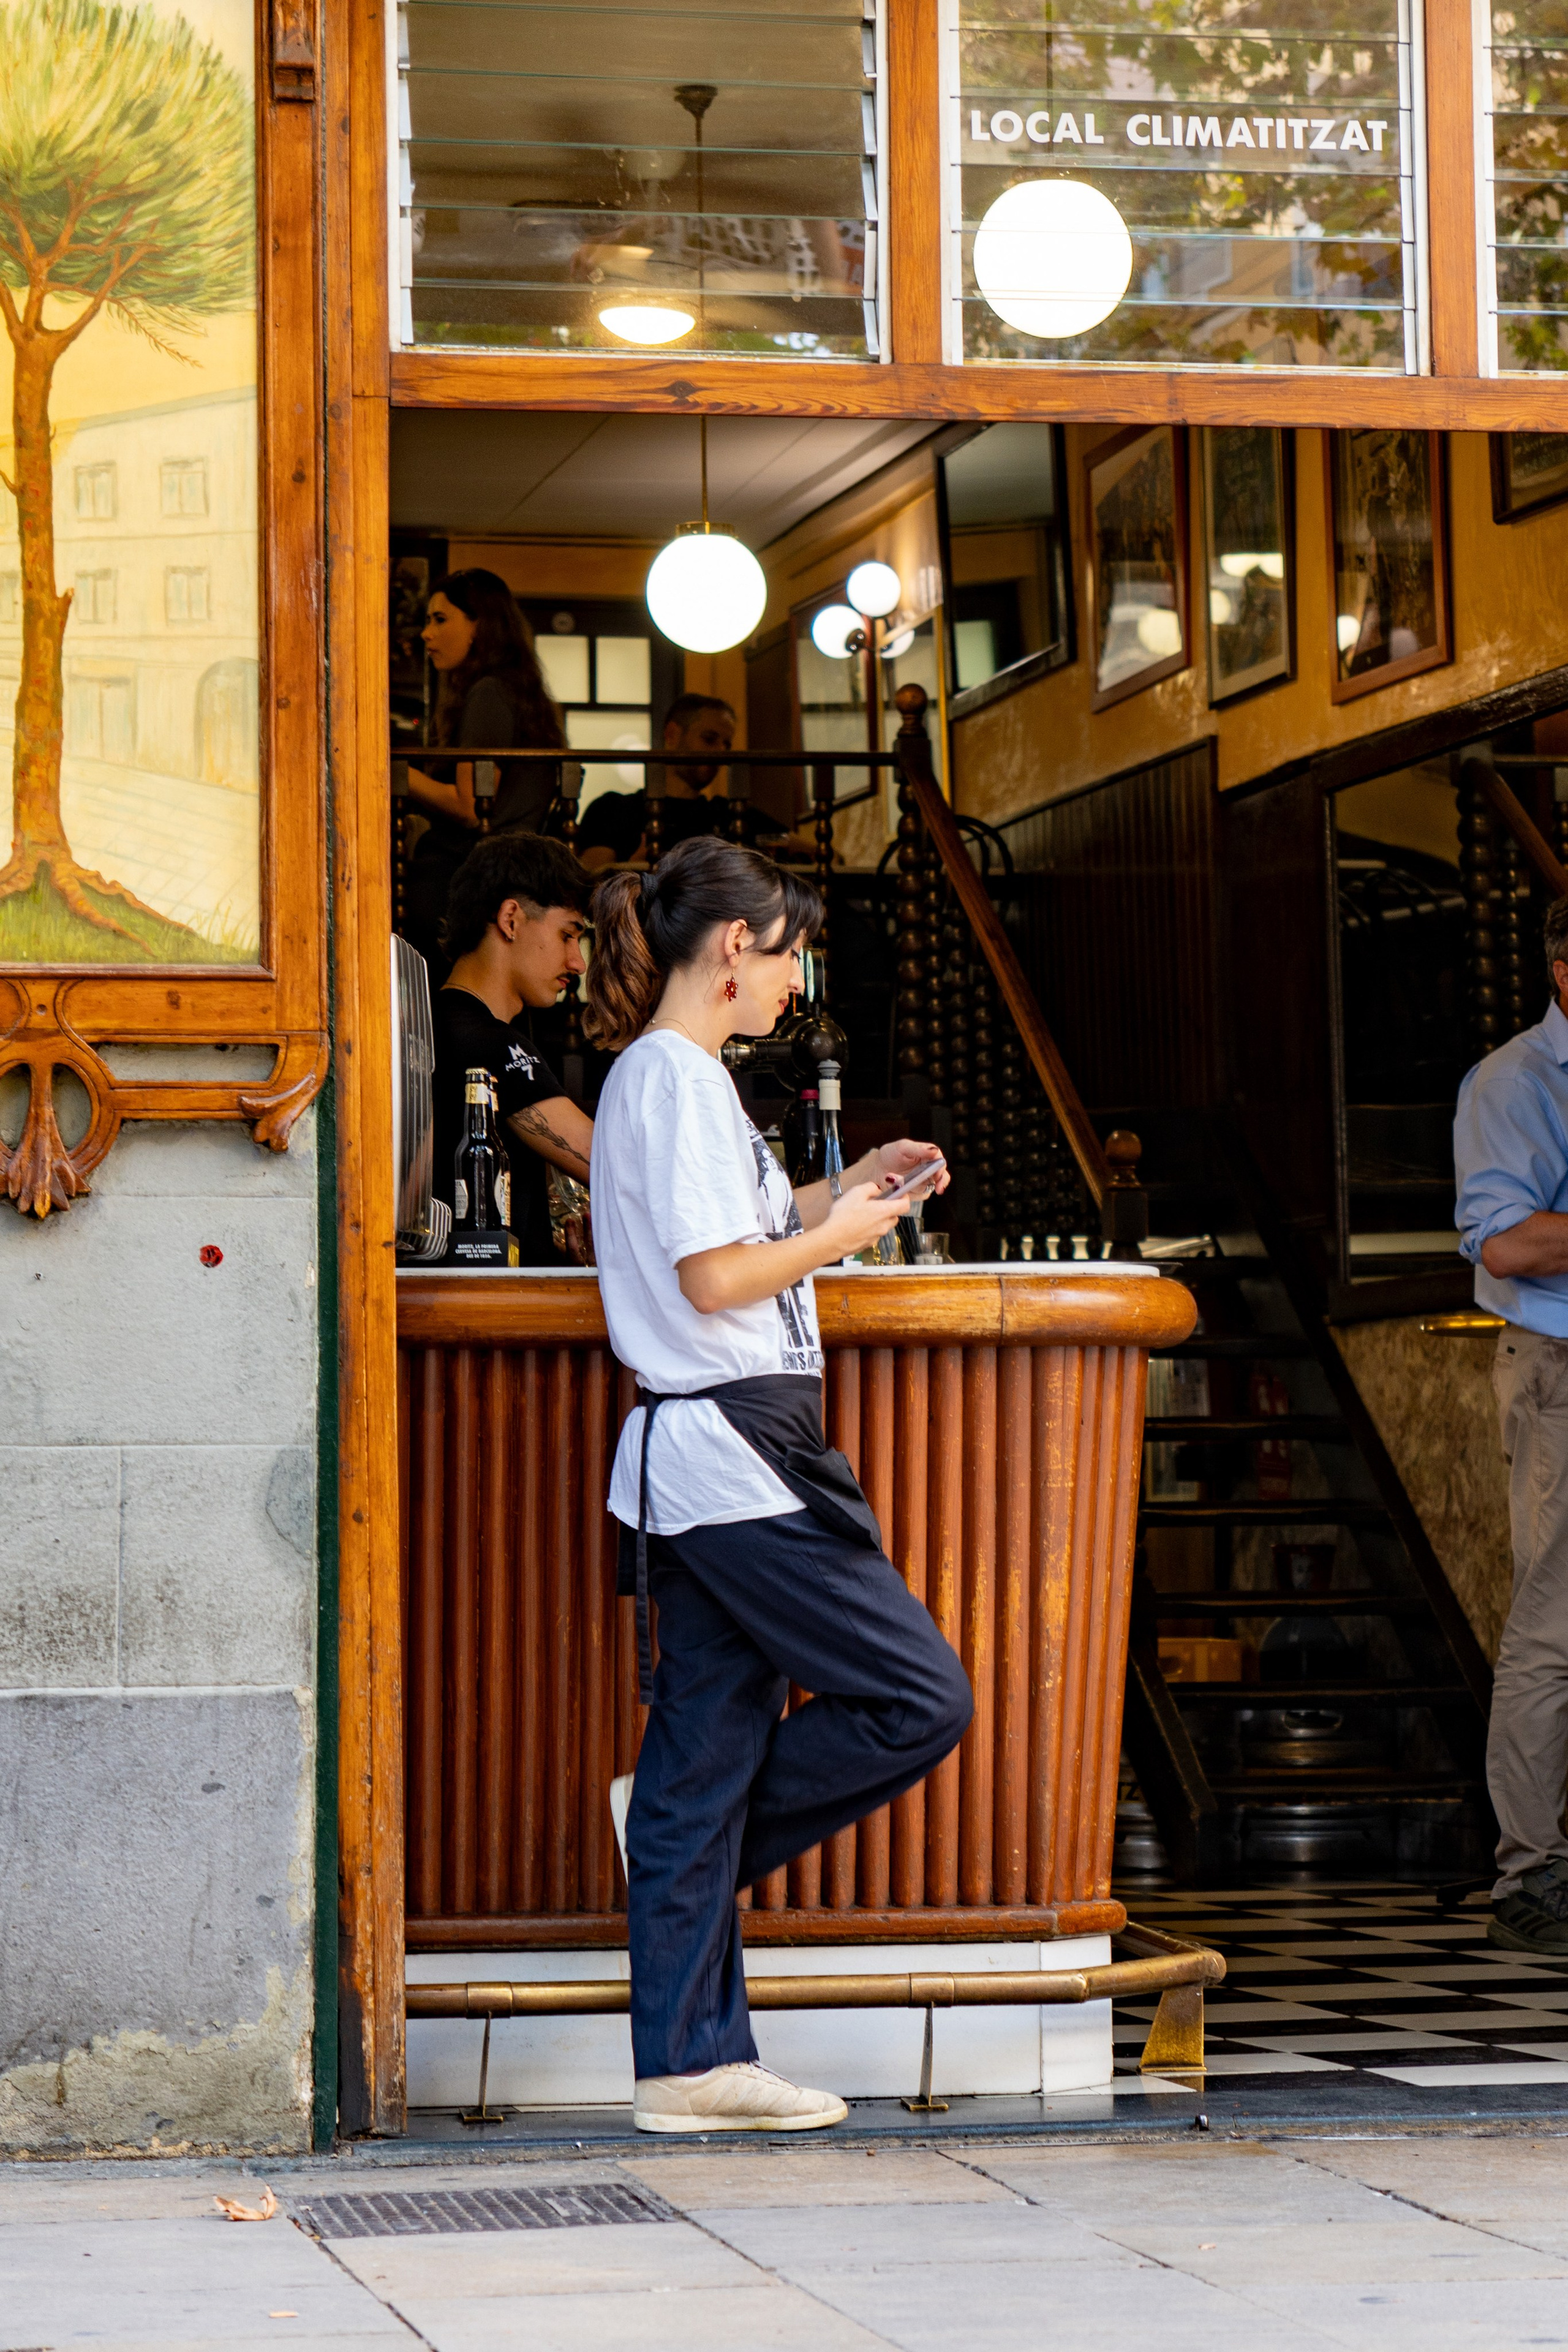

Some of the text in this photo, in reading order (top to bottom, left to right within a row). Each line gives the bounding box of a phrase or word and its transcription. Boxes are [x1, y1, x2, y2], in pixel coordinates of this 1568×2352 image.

[971, 110, 1388, 151] LOCAL CLIMATITZAT
[508, 1043, 528, 1061] M
[505, 1056, 541, 1072] MORITZ
[521, 1063, 534, 1081] 7
